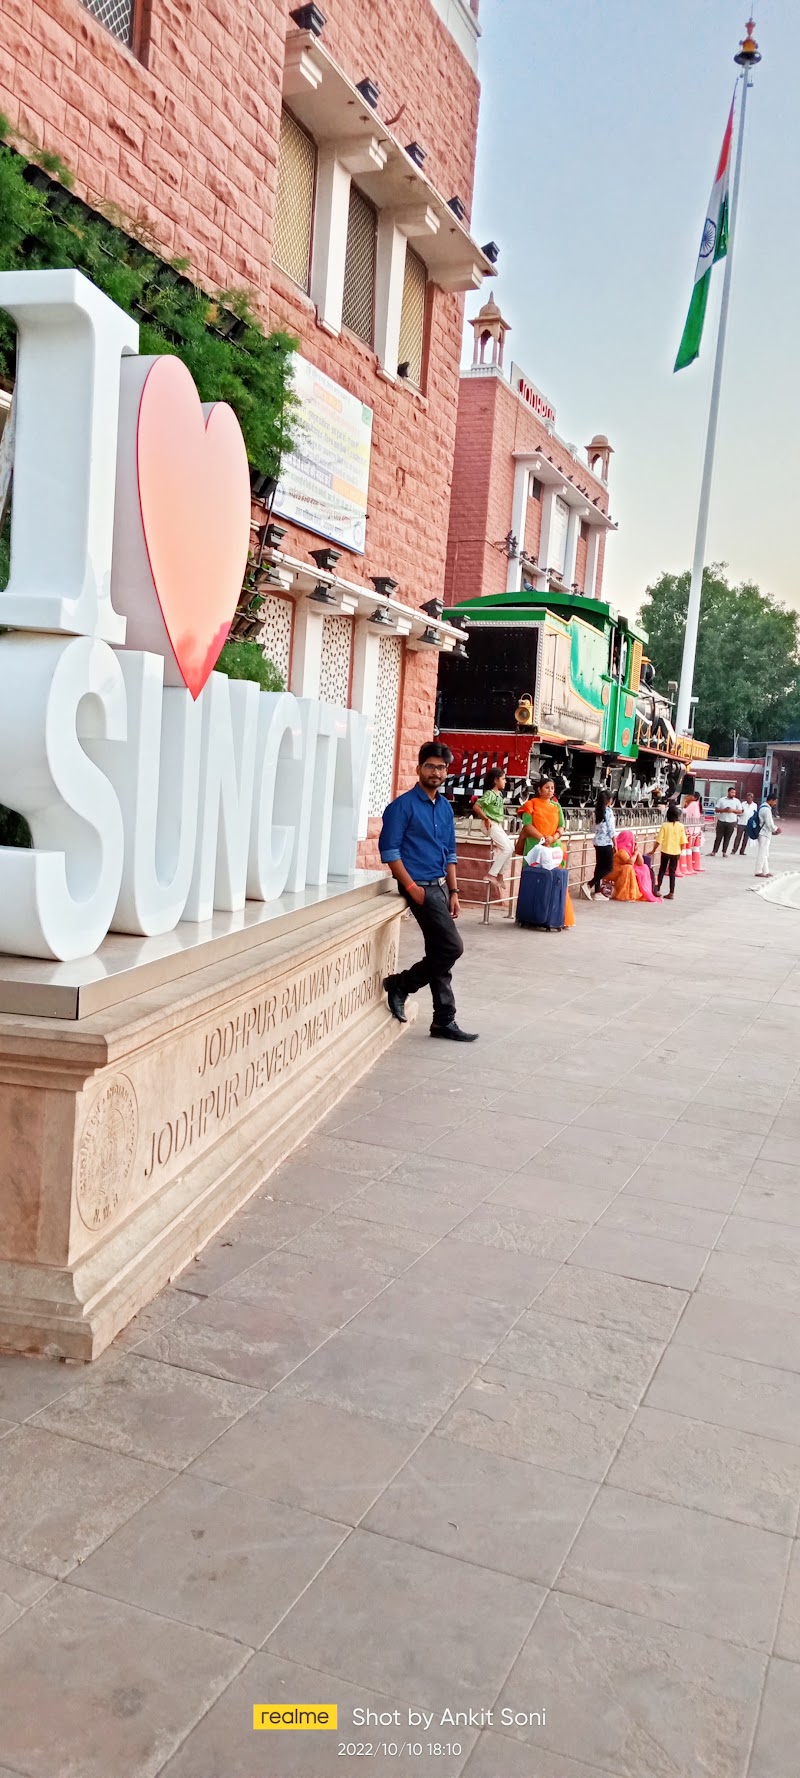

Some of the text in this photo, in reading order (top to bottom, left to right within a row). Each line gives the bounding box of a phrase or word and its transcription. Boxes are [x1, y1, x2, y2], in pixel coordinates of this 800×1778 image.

[0, 635, 372, 962] SUNCITY
[144, 1072, 240, 1177] JODHPUR
[244, 1001, 336, 1099] DEVELOPMENT
[336, 967, 384, 1026] AUTHORITY
[198, 994, 277, 1077] JODHPUR
[280, 961, 334, 1024] RAILWAY
[334, 940, 371, 987] STATION
